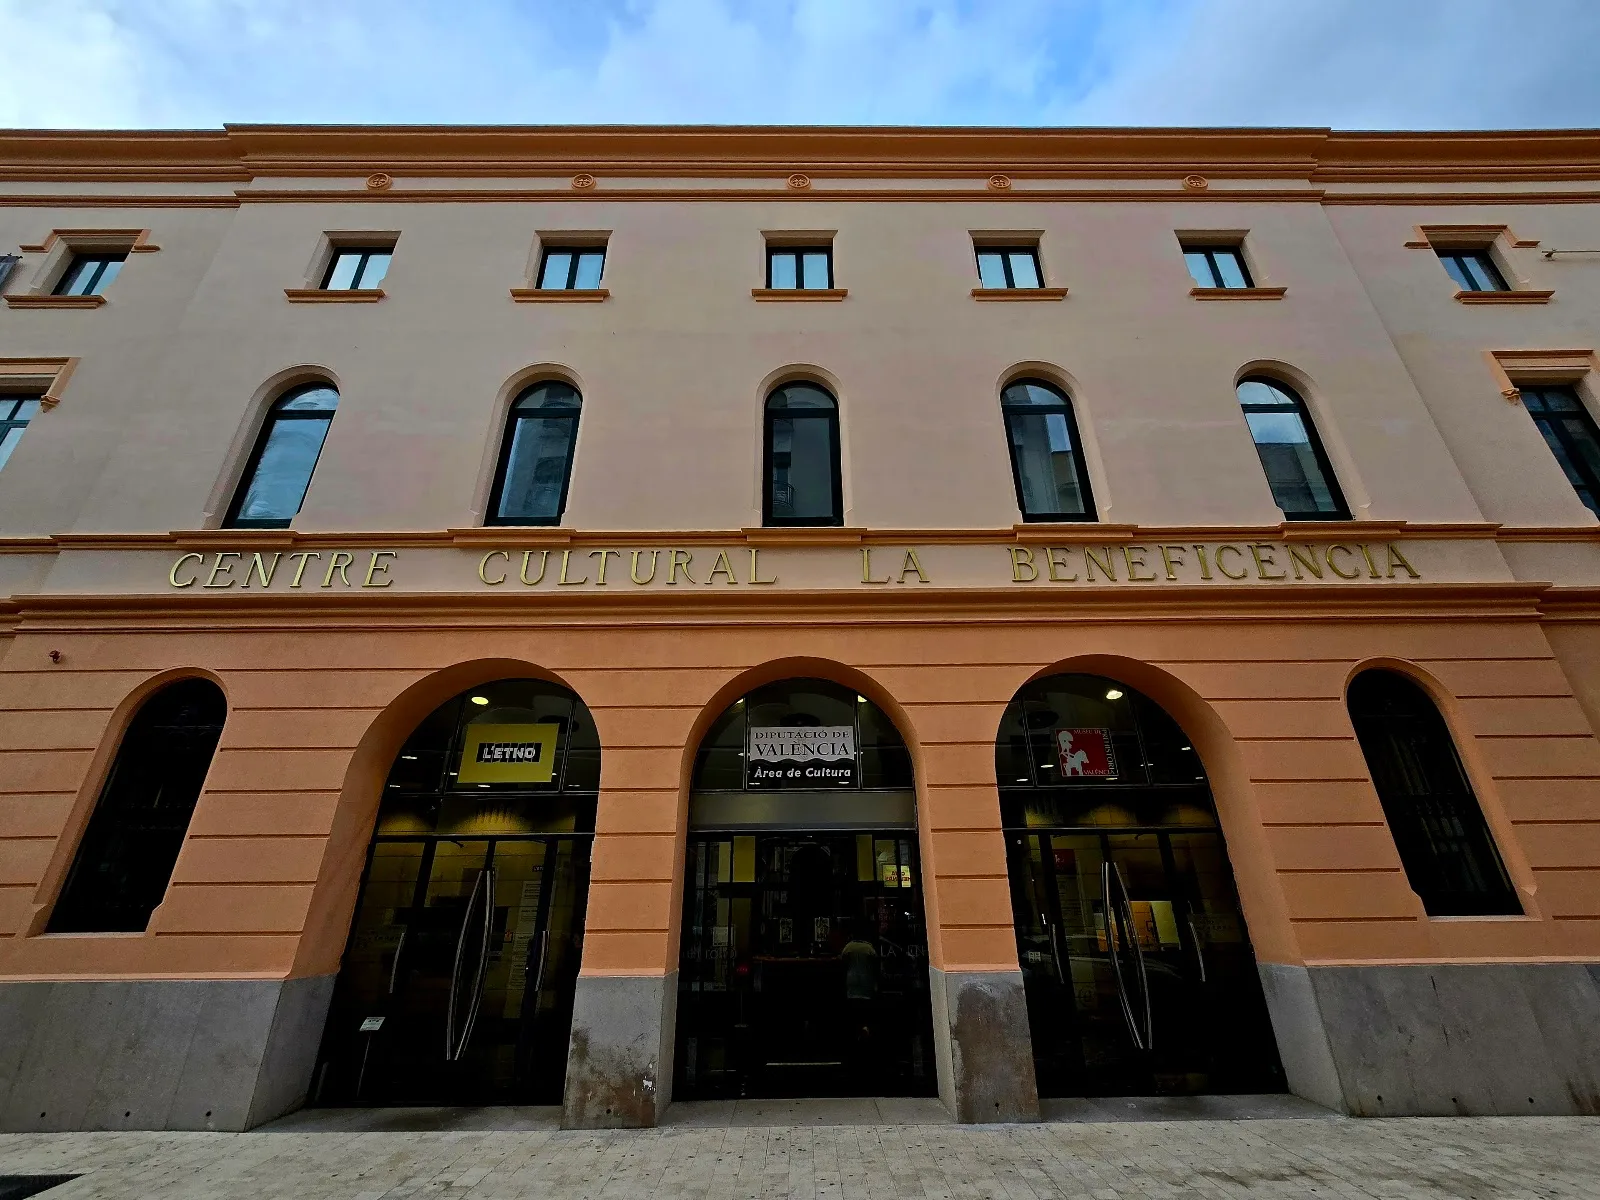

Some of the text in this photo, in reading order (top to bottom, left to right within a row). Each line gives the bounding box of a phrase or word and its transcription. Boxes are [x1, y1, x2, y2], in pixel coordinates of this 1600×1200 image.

[168, 550, 398, 588] CENTRE
[478, 549, 777, 586] CULTURAL
[859, 547, 930, 585] LA
[755, 730, 827, 738] DIPUTACIÓ
[483, 746, 536, 759] L'ETNO
[755, 740, 849, 756] VALÈNCIA
[754, 766, 851, 777] Àrea de Cultura
